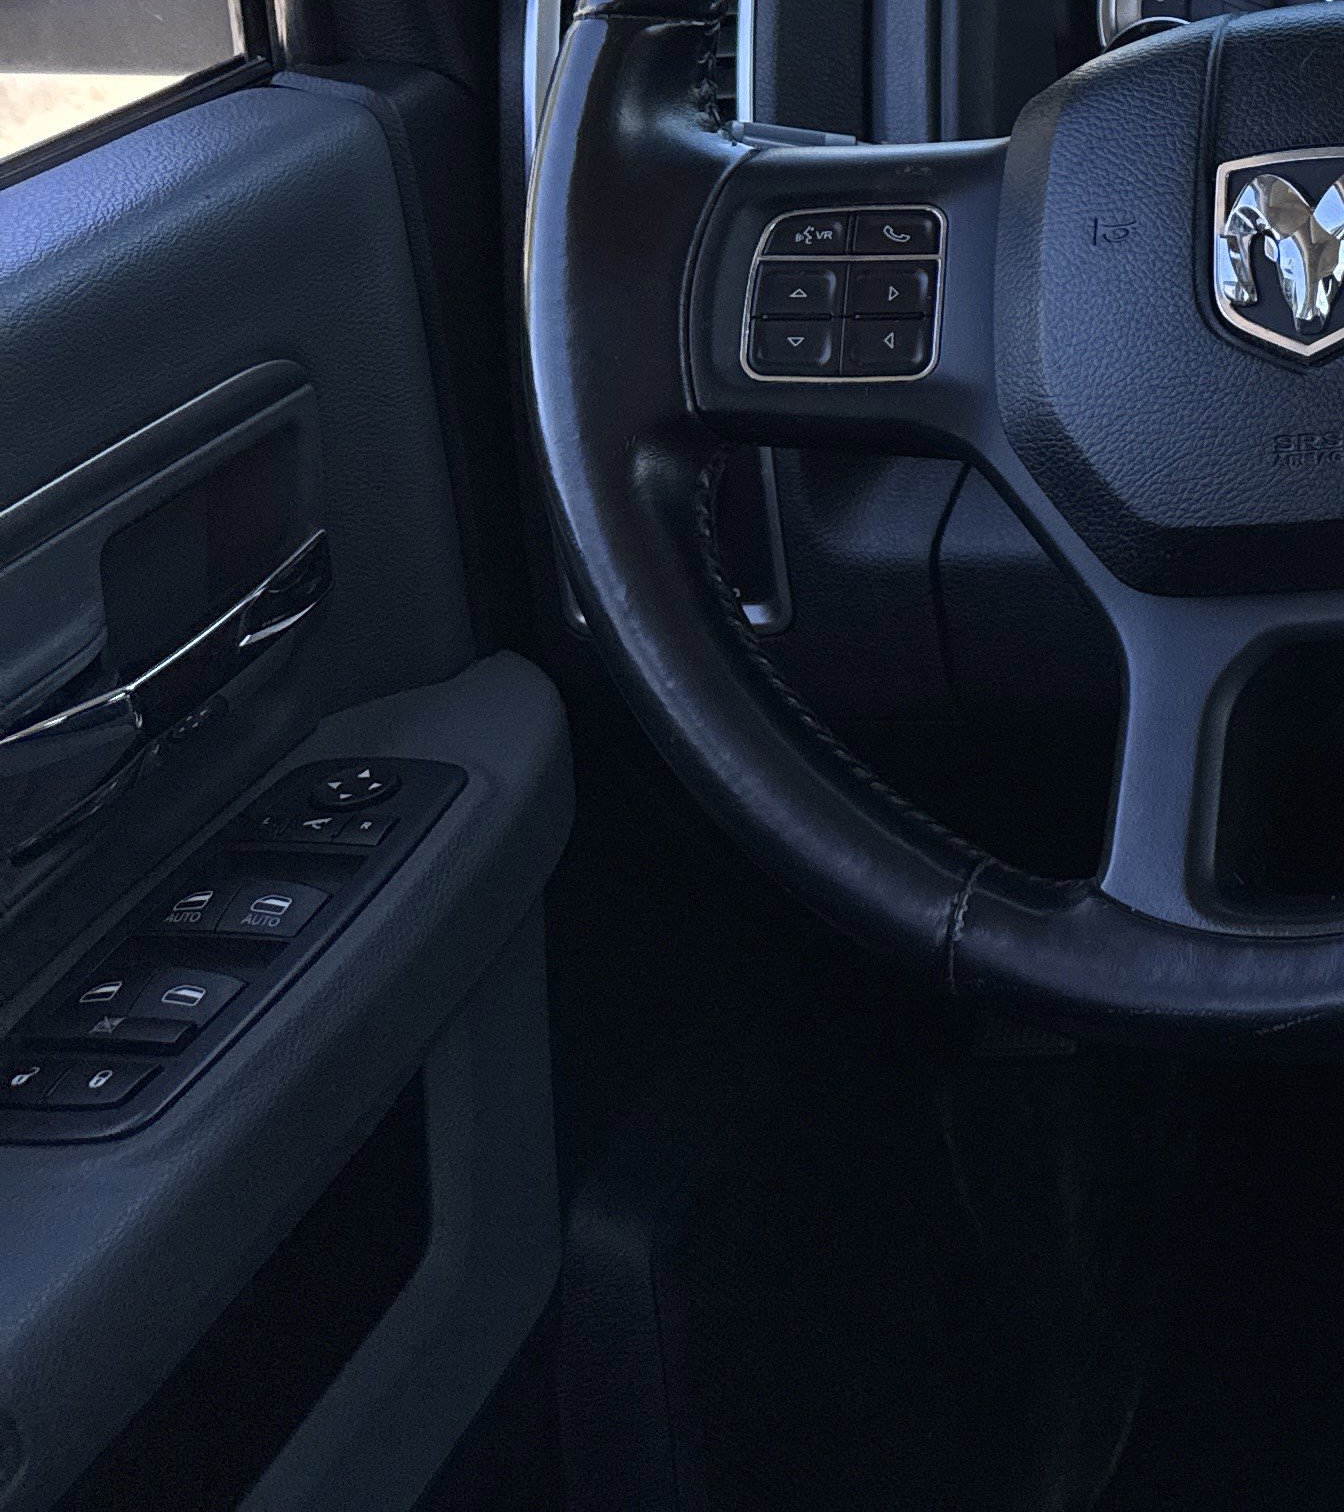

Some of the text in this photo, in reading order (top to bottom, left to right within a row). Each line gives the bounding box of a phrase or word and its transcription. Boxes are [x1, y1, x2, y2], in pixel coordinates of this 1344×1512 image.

[816, 230, 833, 240] VR
[359, 821, 372, 830] R
[164, 911, 202, 924] AUTO
[241, 914, 281, 927] AUTO
